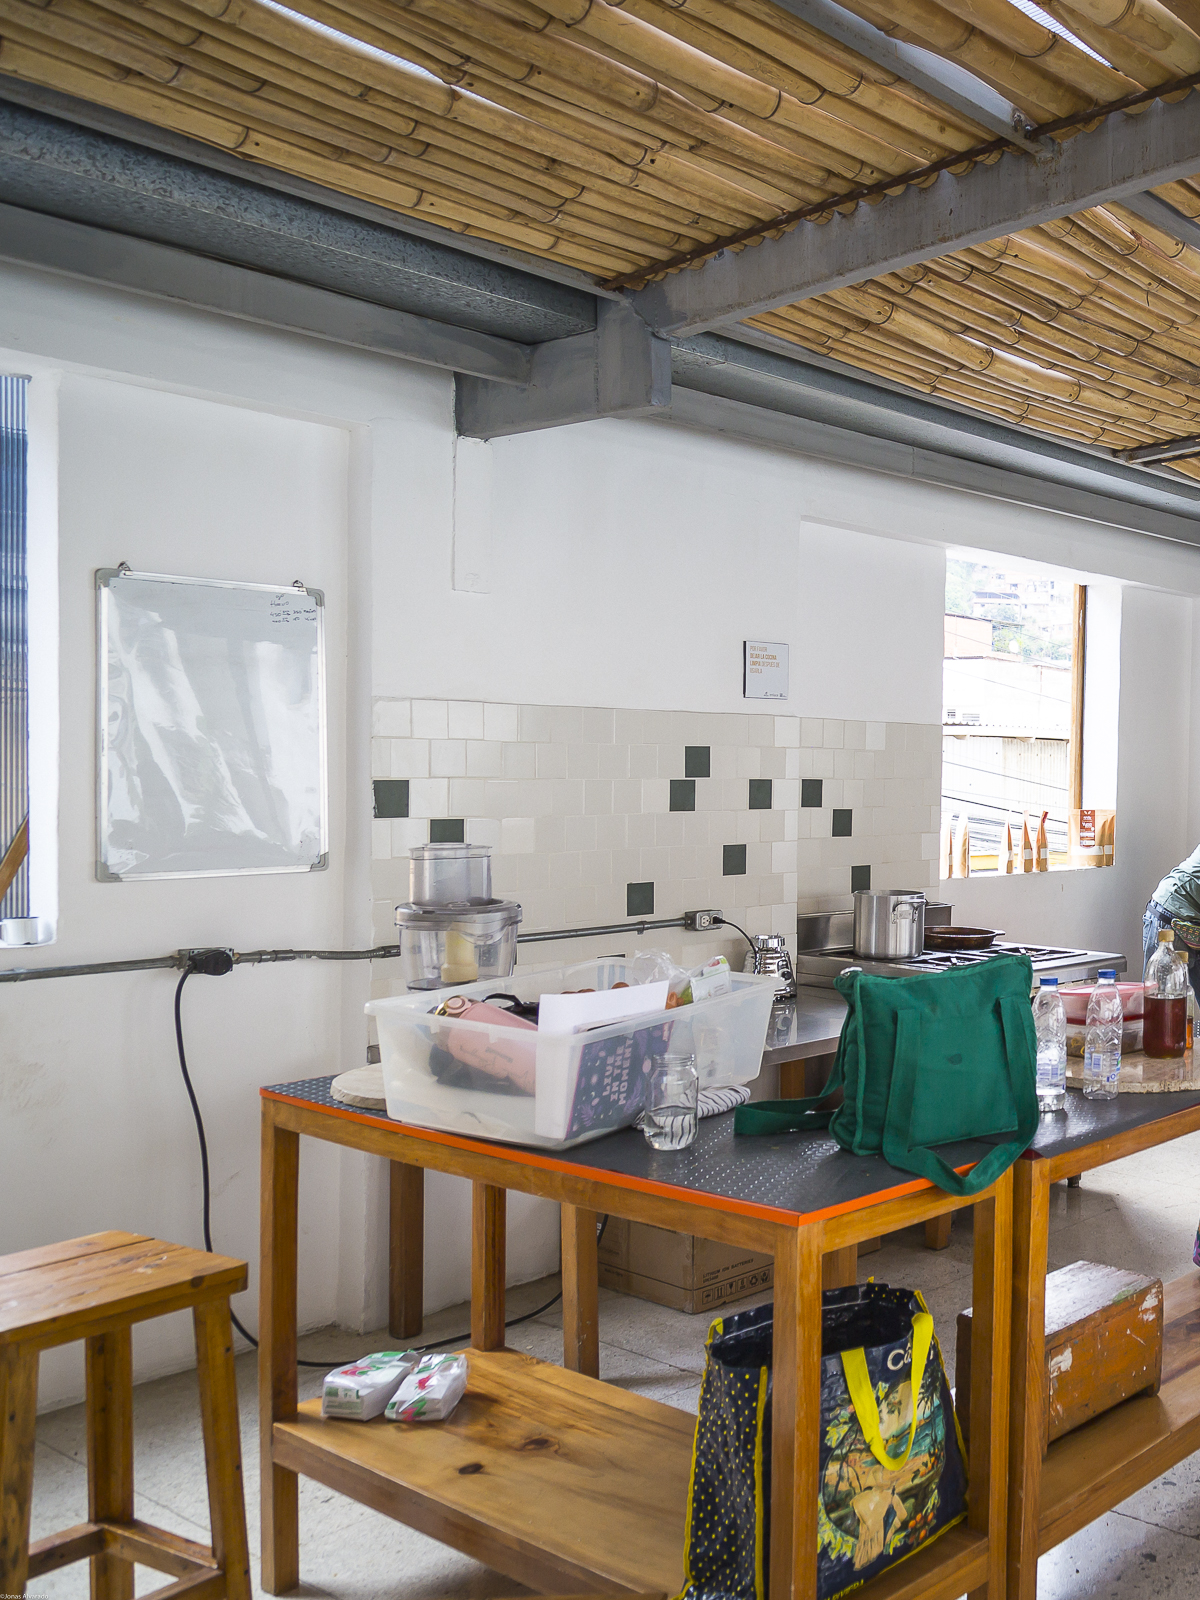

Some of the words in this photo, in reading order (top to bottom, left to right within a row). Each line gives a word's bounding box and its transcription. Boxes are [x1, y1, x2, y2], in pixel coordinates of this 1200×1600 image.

[602, 1055, 615, 1097] LIVE
[613, 1045, 625, 1077] THE
[619, 1038, 634, 1106] MOMENT
[610, 1081, 620, 1102] IN
[702, 1268, 721, 1279] LITHIUM
[730, 1258, 754, 1270] BATTERIES
